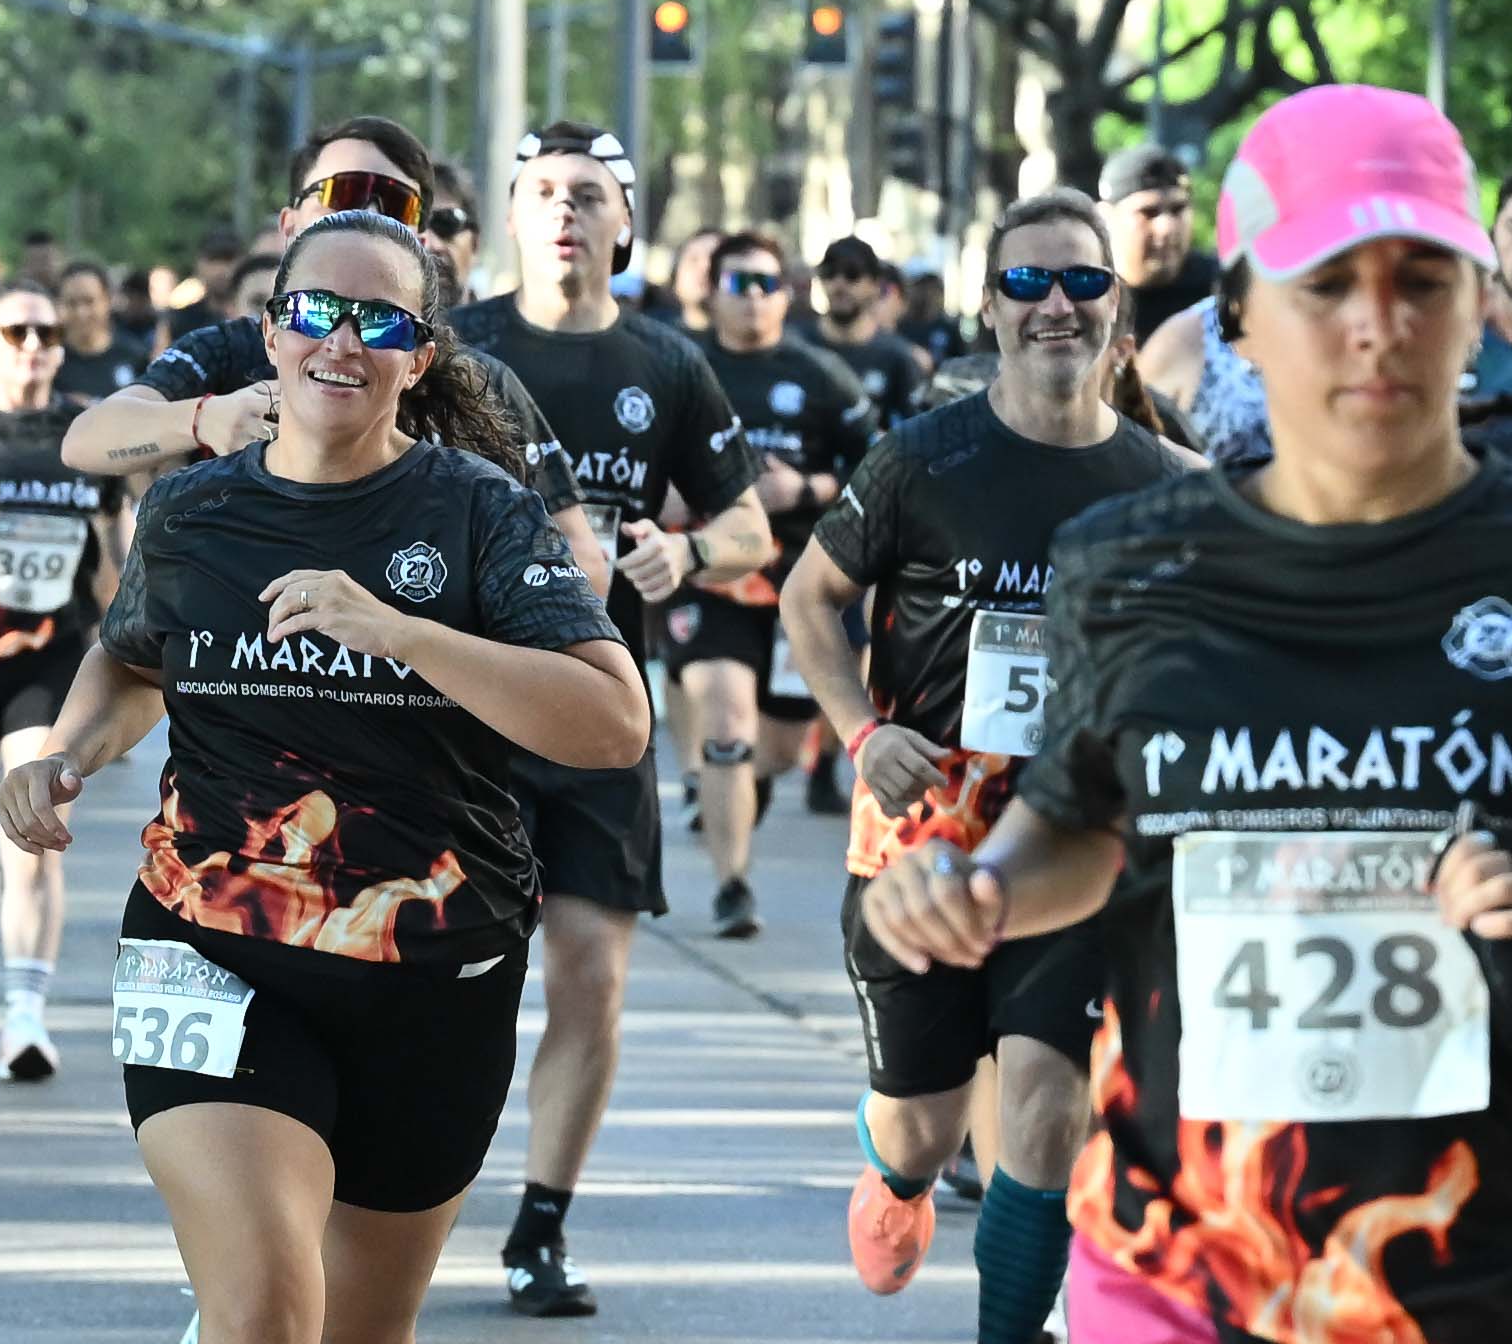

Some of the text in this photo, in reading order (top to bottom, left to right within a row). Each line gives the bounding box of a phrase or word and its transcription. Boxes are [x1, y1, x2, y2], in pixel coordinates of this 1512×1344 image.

[176, 679, 238, 697] ASOCIACIÓN
[241, 682, 314, 698] BOMBEROS
[316, 688, 405, 706] VOLUNTARIOS
[136, 958, 231, 986] MARATÓN
[1213, 933, 1443, 1031] 428
[113, 1006, 213, 1072] 536
